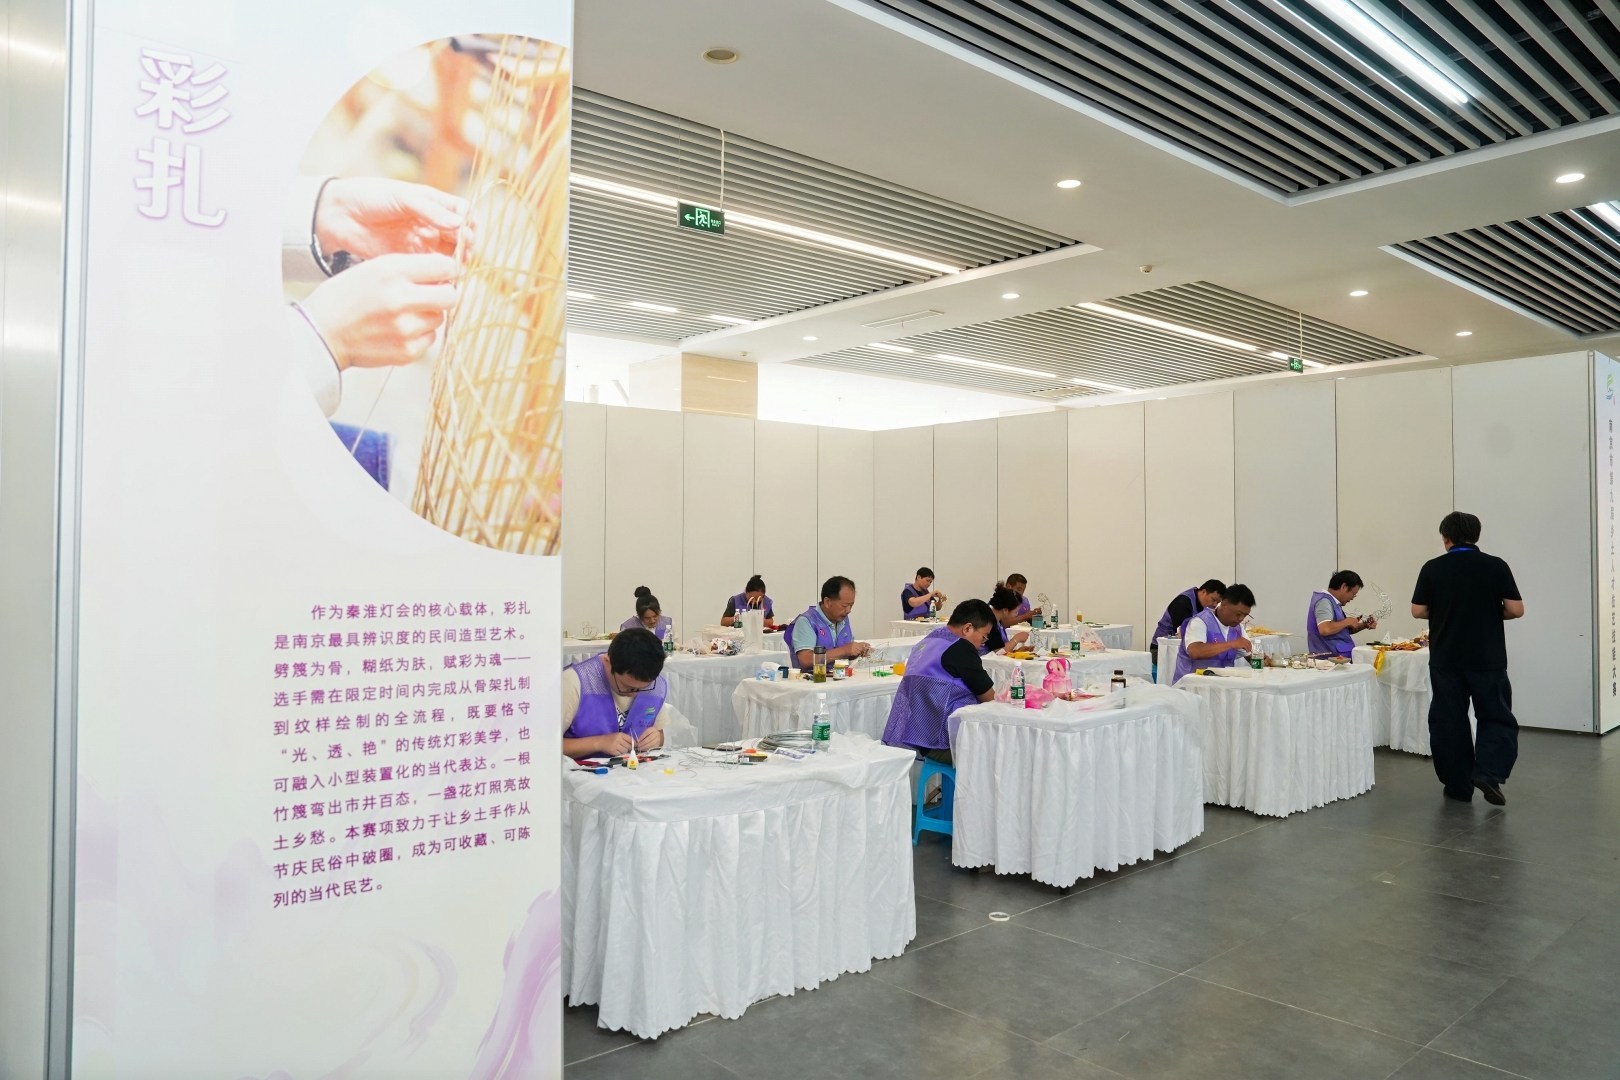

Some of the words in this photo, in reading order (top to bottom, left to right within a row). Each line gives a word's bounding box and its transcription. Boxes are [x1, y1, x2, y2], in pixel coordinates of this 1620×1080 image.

[134, 47, 231, 228] 彩扎
[311, 601, 531, 620] 作为秦淮灯会的核心载体，彩扎
[274, 627, 526, 650] 是南京最具辨识度的民间造型艺术。
[273, 676, 531, 707] 选手需在限定时间内完成从骨架扎制
[273, 701, 531, 735] 到纹样绘制的全流程，既要恪守
[273, 752, 531, 792] 可融入小型装置化的当代表达。一根
[273, 776, 531, 822] 竹篾弯出市井百态，一盏花灯照亮故
[273, 801, 531, 850] 土乡愁。本赛项致力于让乡土手作从
[273, 826, 531, 879] 节庆民俗中破圈，成为可收藏、可陈
[273, 877, 384, 908] 列的当代民艺。
